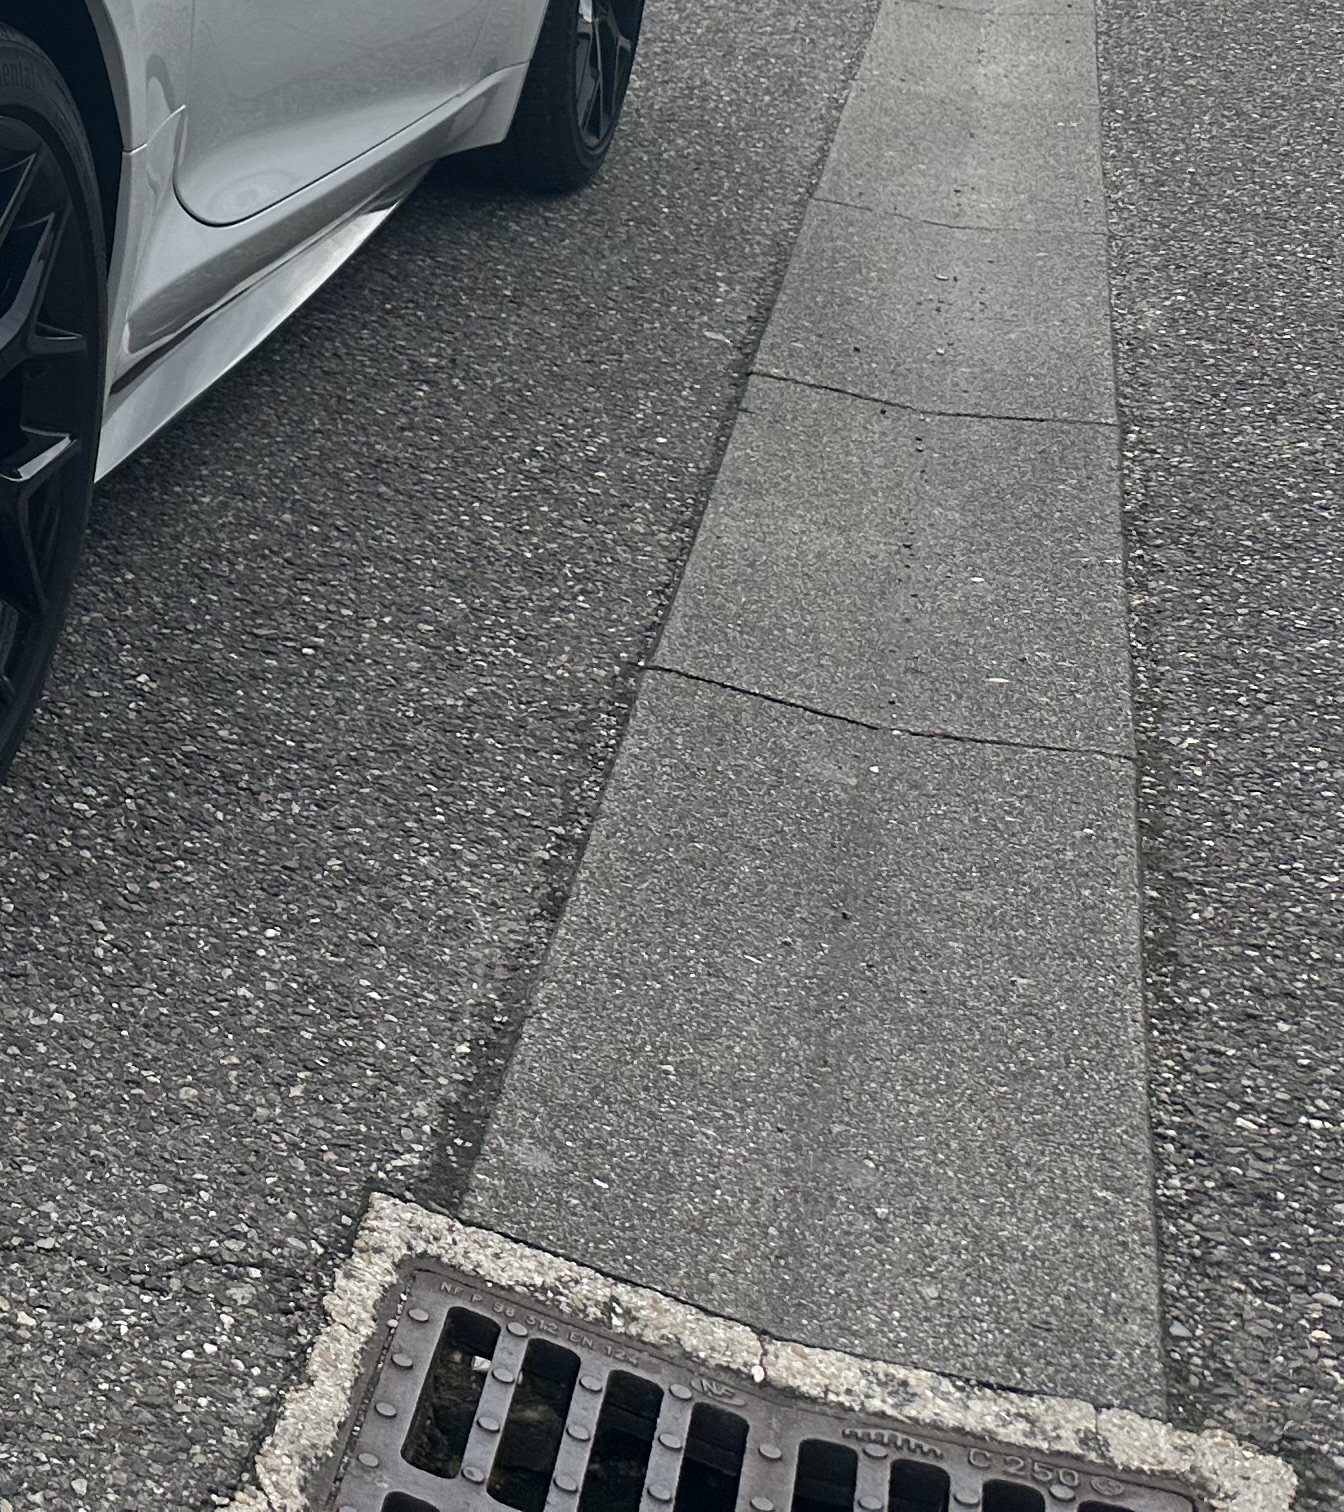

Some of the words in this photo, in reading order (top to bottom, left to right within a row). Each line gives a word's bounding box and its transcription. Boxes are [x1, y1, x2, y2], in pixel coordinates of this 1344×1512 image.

[568, 1332, 594, 1350] EN
[968, 1448, 992, 1470] C
[1003, 1455, 1080, 1489] 250
